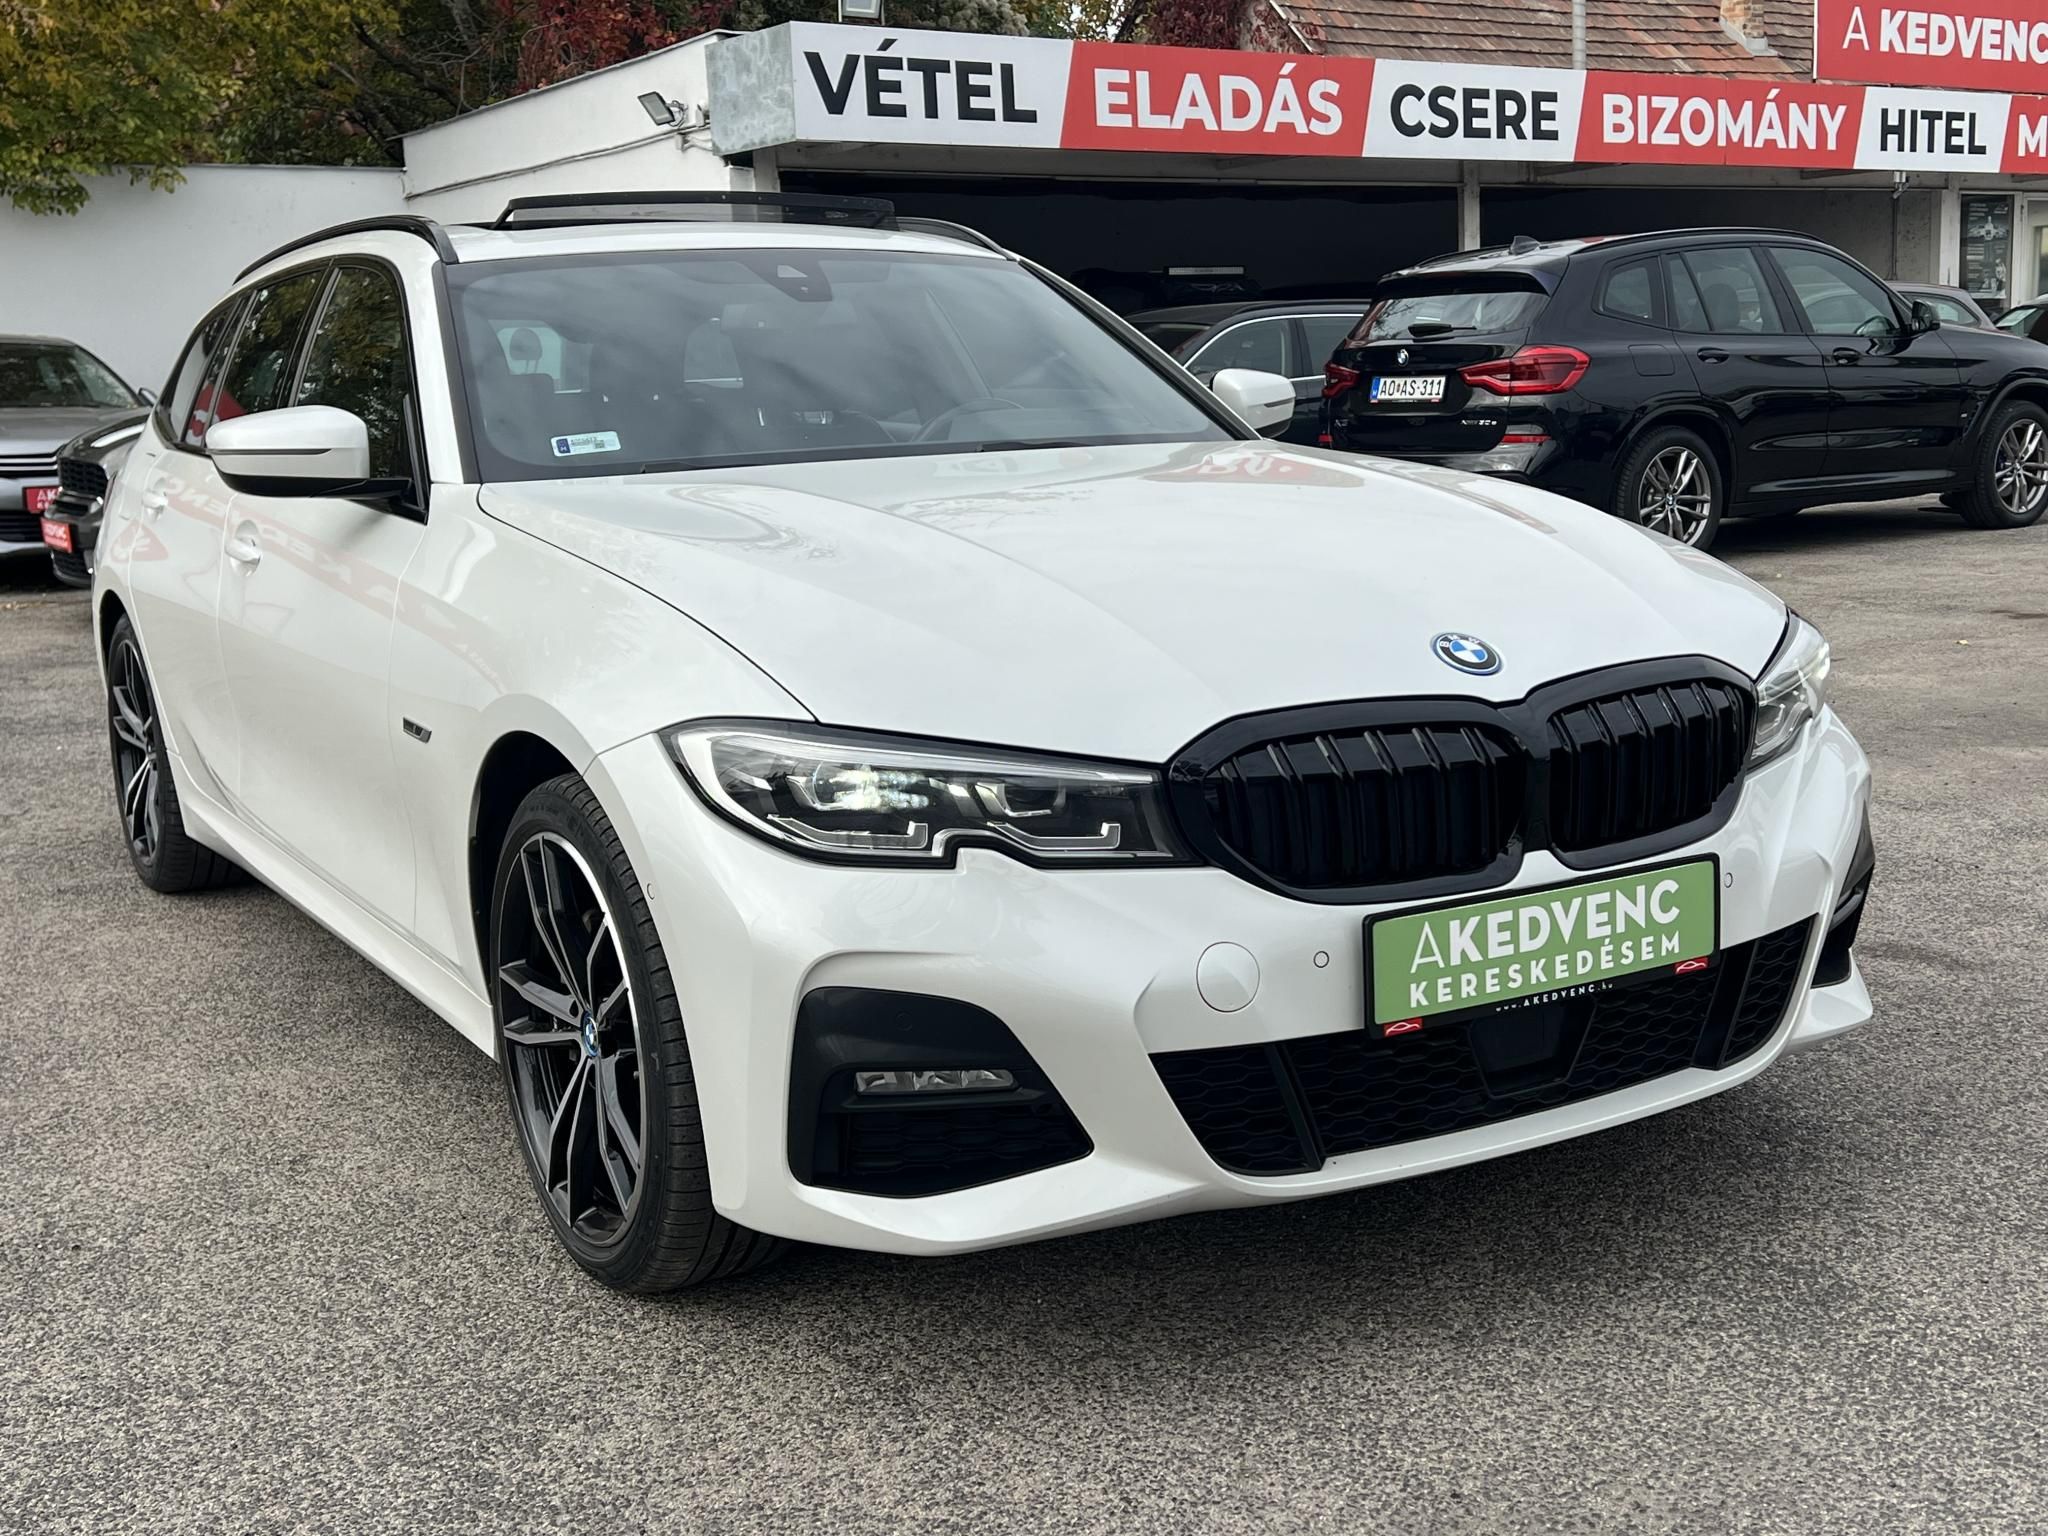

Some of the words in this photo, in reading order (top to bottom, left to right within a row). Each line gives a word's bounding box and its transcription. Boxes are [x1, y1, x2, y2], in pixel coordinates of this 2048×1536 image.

[1843, 7, 1869, 50] A
[1880, 9, 2048, 64] KEDVENC
[804, 38, 1037, 123] VÉTEL
[1094, 62, 1342, 135] ELADÁS
[1390, 84, 1558, 140] CSERE
[1602, 89, 1847, 150] BIZOMÁNY
[1880, 108, 1987, 154] HITEL
[2018, 114, 2048, 157] M
[1410, 931, 1680, 1008] KERESKEDÉSEM
